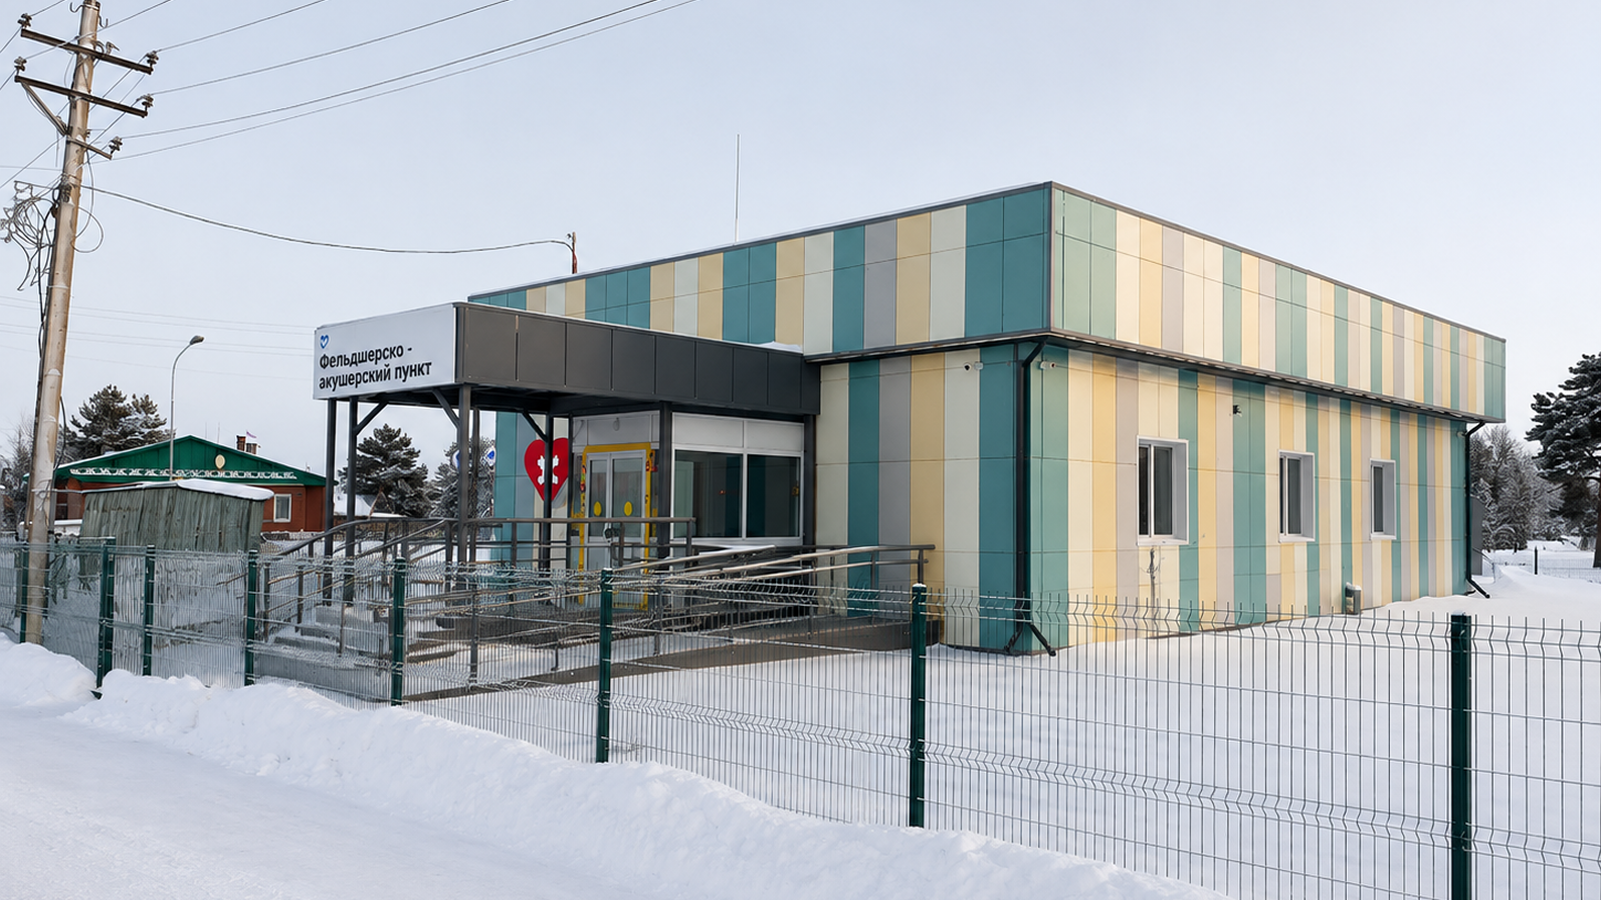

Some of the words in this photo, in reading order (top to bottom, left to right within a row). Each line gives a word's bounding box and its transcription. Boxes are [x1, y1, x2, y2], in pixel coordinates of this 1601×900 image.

[319, 345, 403, 369] Фельдшерско
[319, 364, 391, 392] акушерский
[394, 362, 432, 382] пункт
